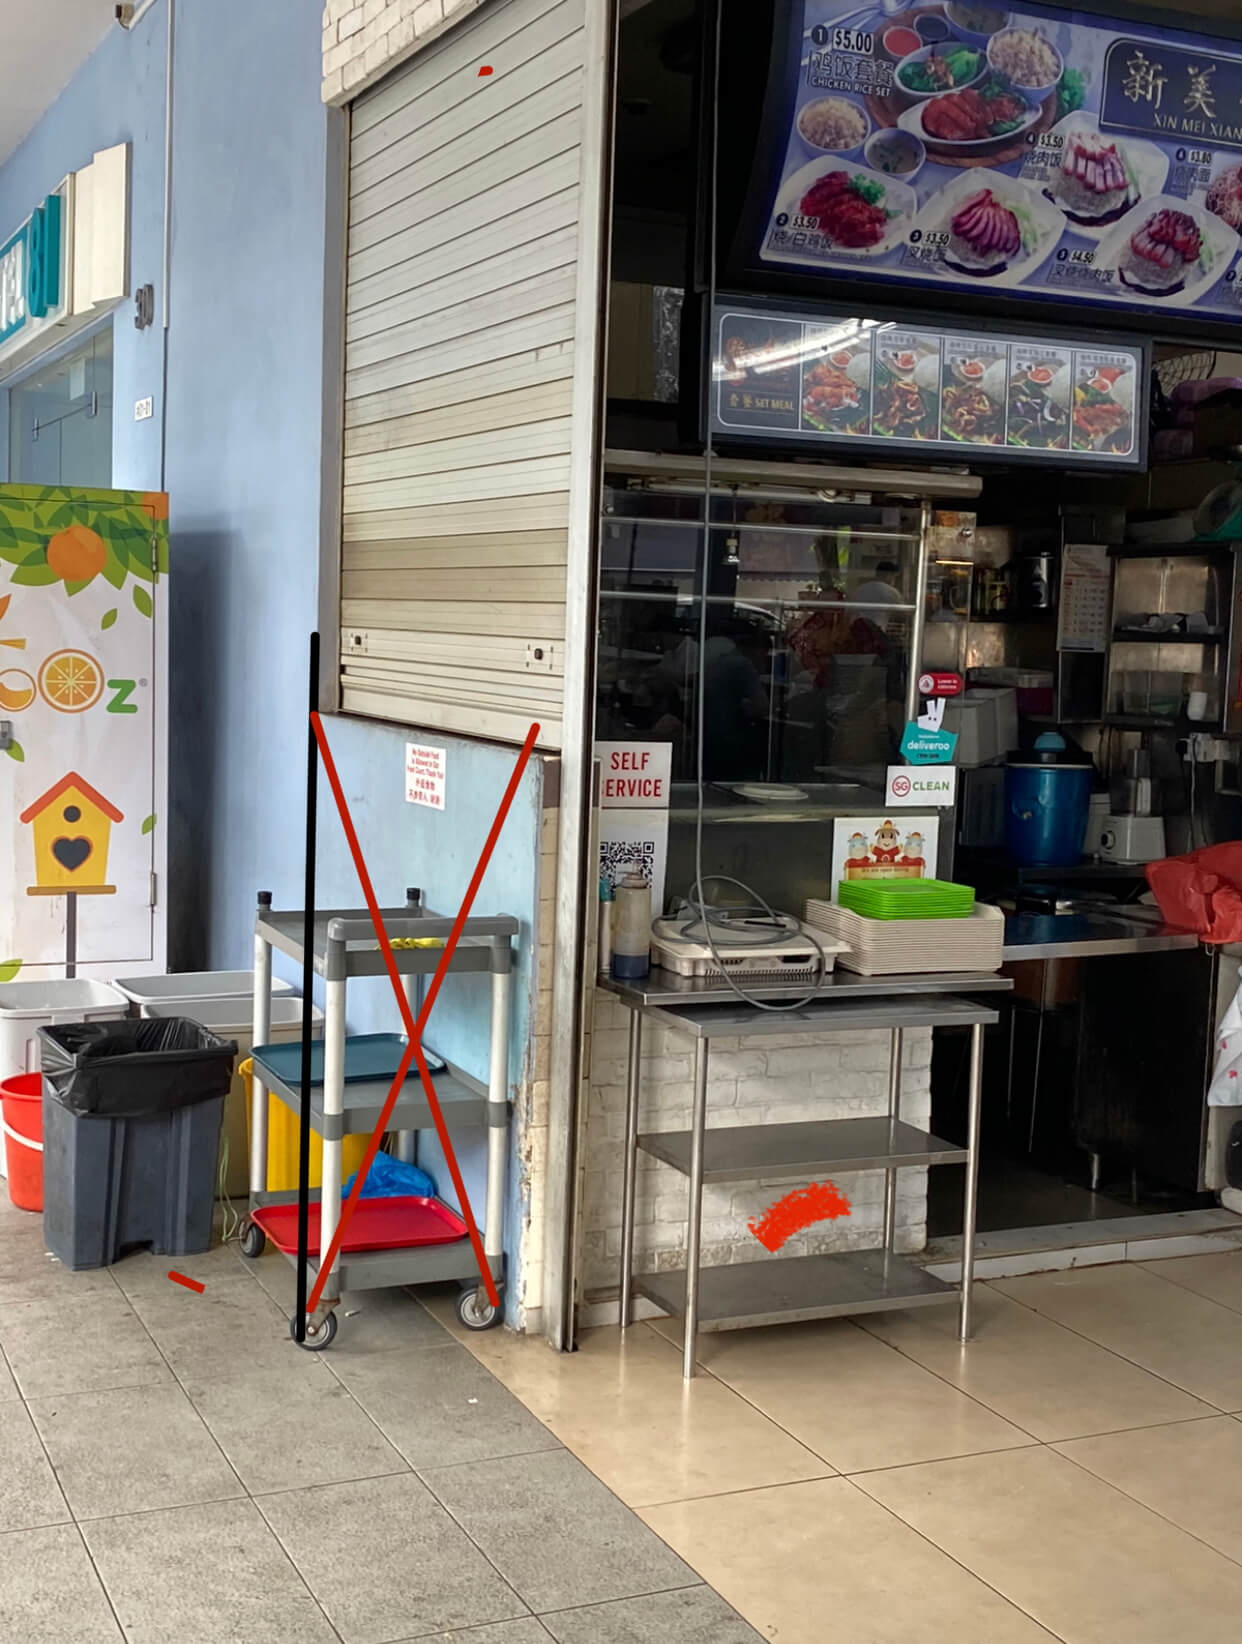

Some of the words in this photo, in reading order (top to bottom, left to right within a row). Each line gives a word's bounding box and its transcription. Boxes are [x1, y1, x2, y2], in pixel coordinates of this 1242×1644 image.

[835, 29, 872, 53] $5.00
[812, 77, 851, 90] CHICKEN
[854, 83, 873, 94] RICE
[876, 86, 890, 96] SET
[1153, 112, 1177, 129] XIN
[1181, 118, 1206, 135] MEI
[1040, 133, 1064, 149] $3.50
[792, 217, 818, 230] $3.50
[924, 233, 950, 246] $3.50
[1070, 250, 1095, 264] $4.50
[907, 740, 950, 751] deliveroo
[611, 751, 651, 771] SELF
[602, 778, 663, 798] ERVICE
[895, 780, 908, 791] SG
[912, 781, 950, 792] CLEAN
